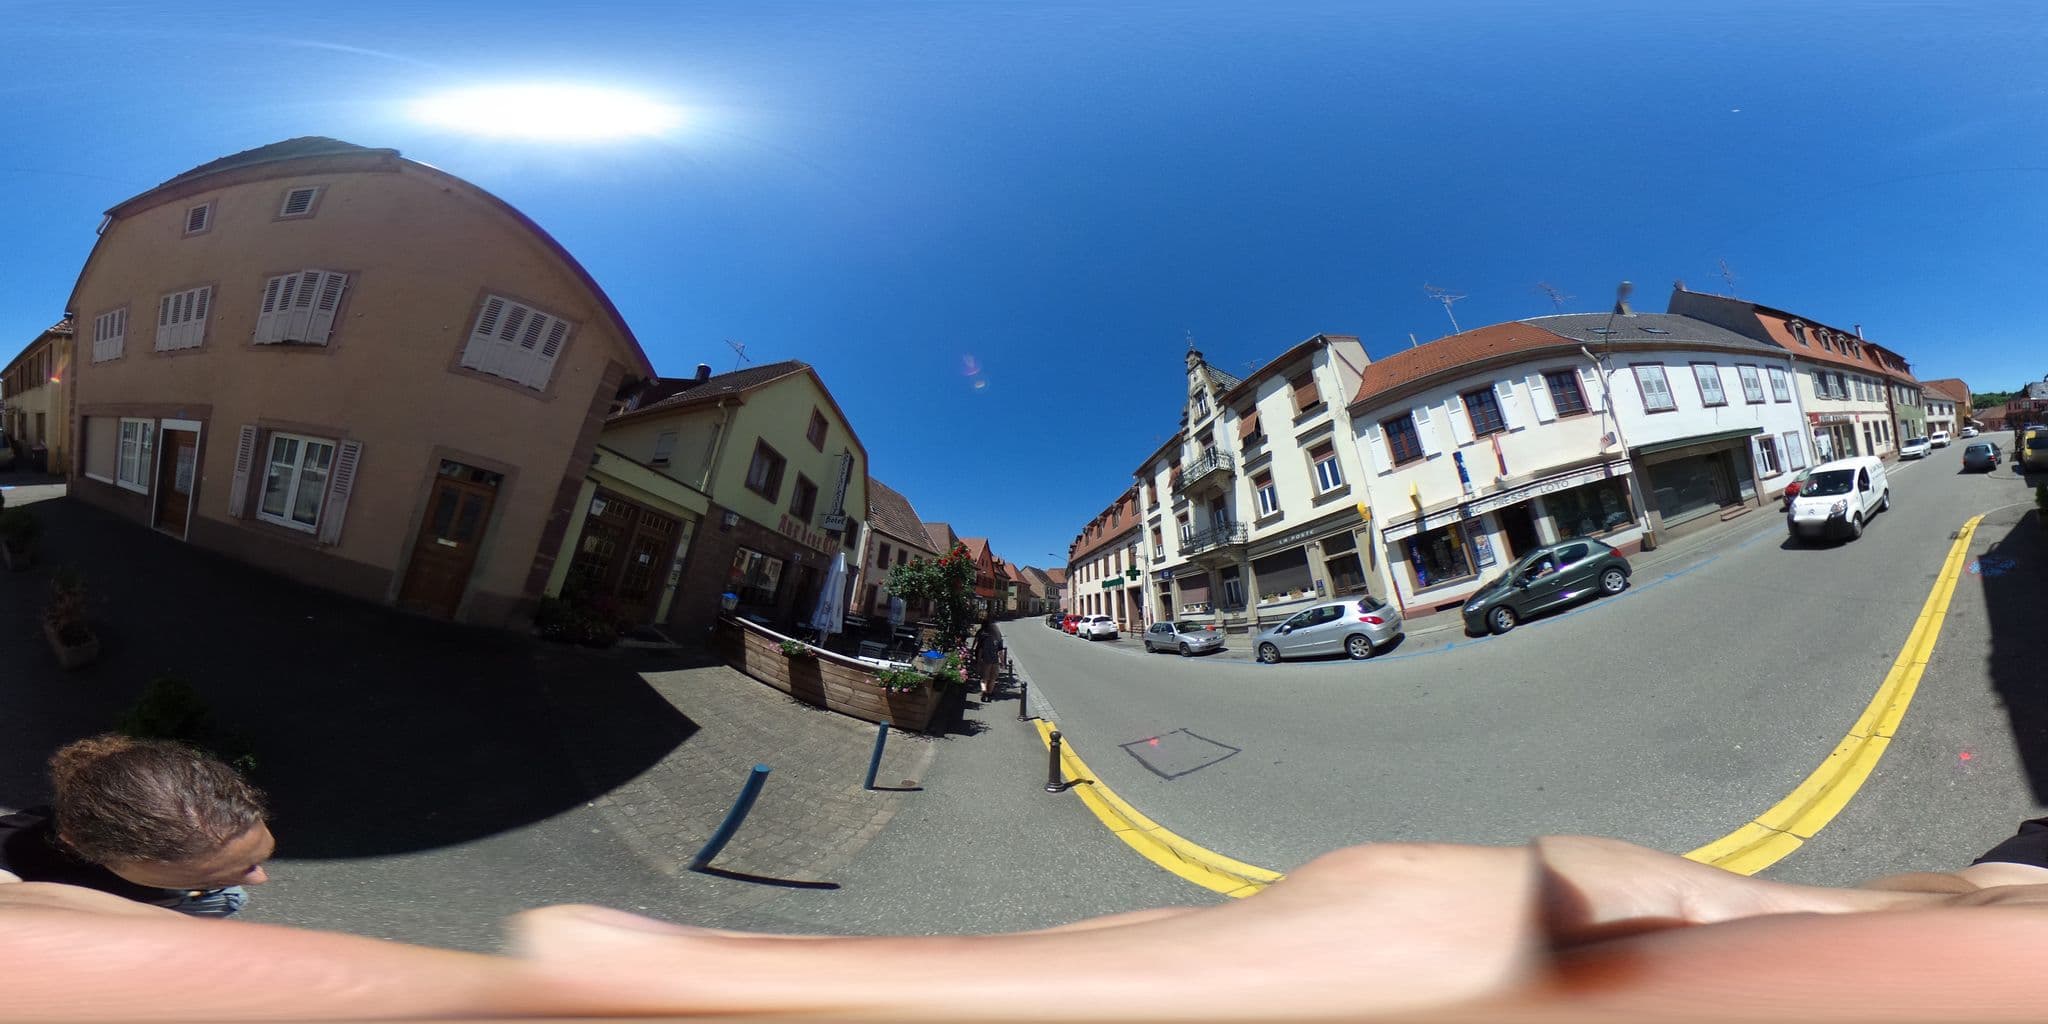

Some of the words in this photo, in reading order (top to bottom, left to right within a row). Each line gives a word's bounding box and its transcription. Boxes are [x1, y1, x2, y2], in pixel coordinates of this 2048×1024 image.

[1493, 491, 1530, 506] PRESSE
[1540, 481, 1569, 494] LOTO
[1291, 530, 1314, 540] POSTE
